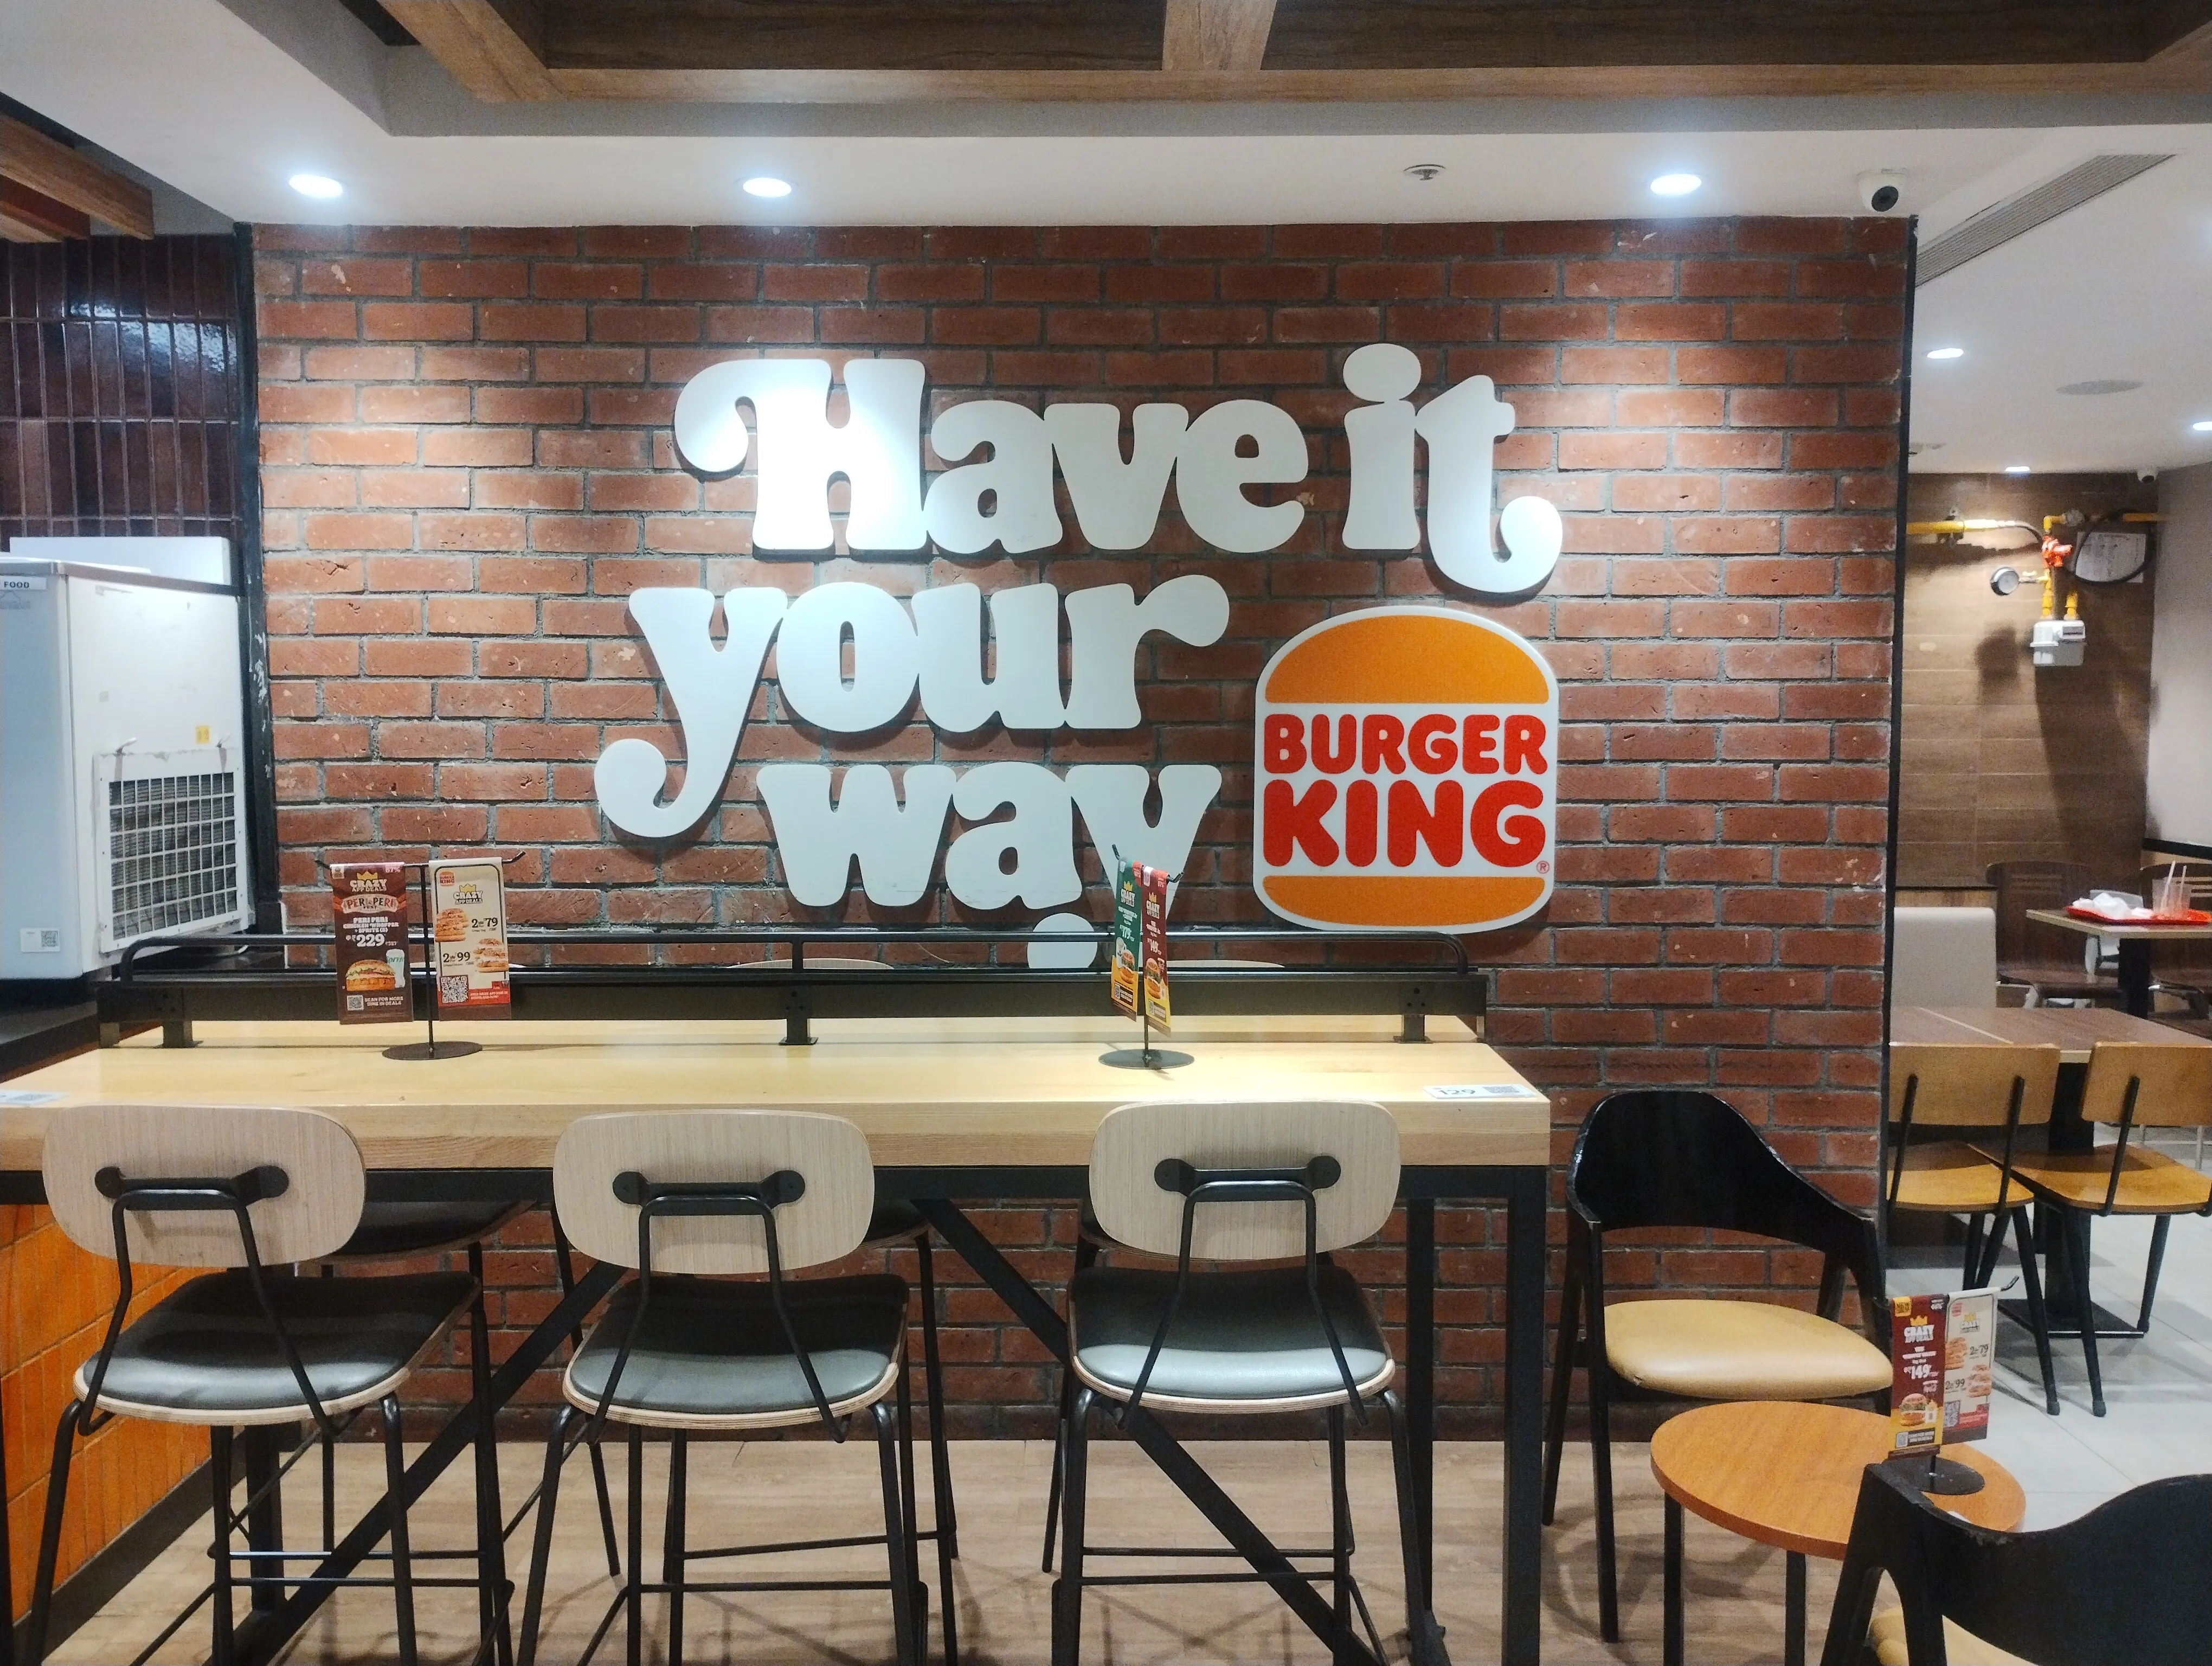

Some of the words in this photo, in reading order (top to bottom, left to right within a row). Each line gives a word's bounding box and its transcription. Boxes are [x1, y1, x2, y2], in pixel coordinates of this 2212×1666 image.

[674, 358, 1308, 554] Have
[1342, 344, 1563, 593] it
[3, 581, 30, 589] FOOD
[594, 574, 1230, 838] your
[1264, 713, 1548, 775] BURGER
[1263, 779, 1546, 868] KING
[350, 879, 387, 888] CRAZY
[453, 890, 483, 900] CRAZY
[757, 762, 1222, 969] way
